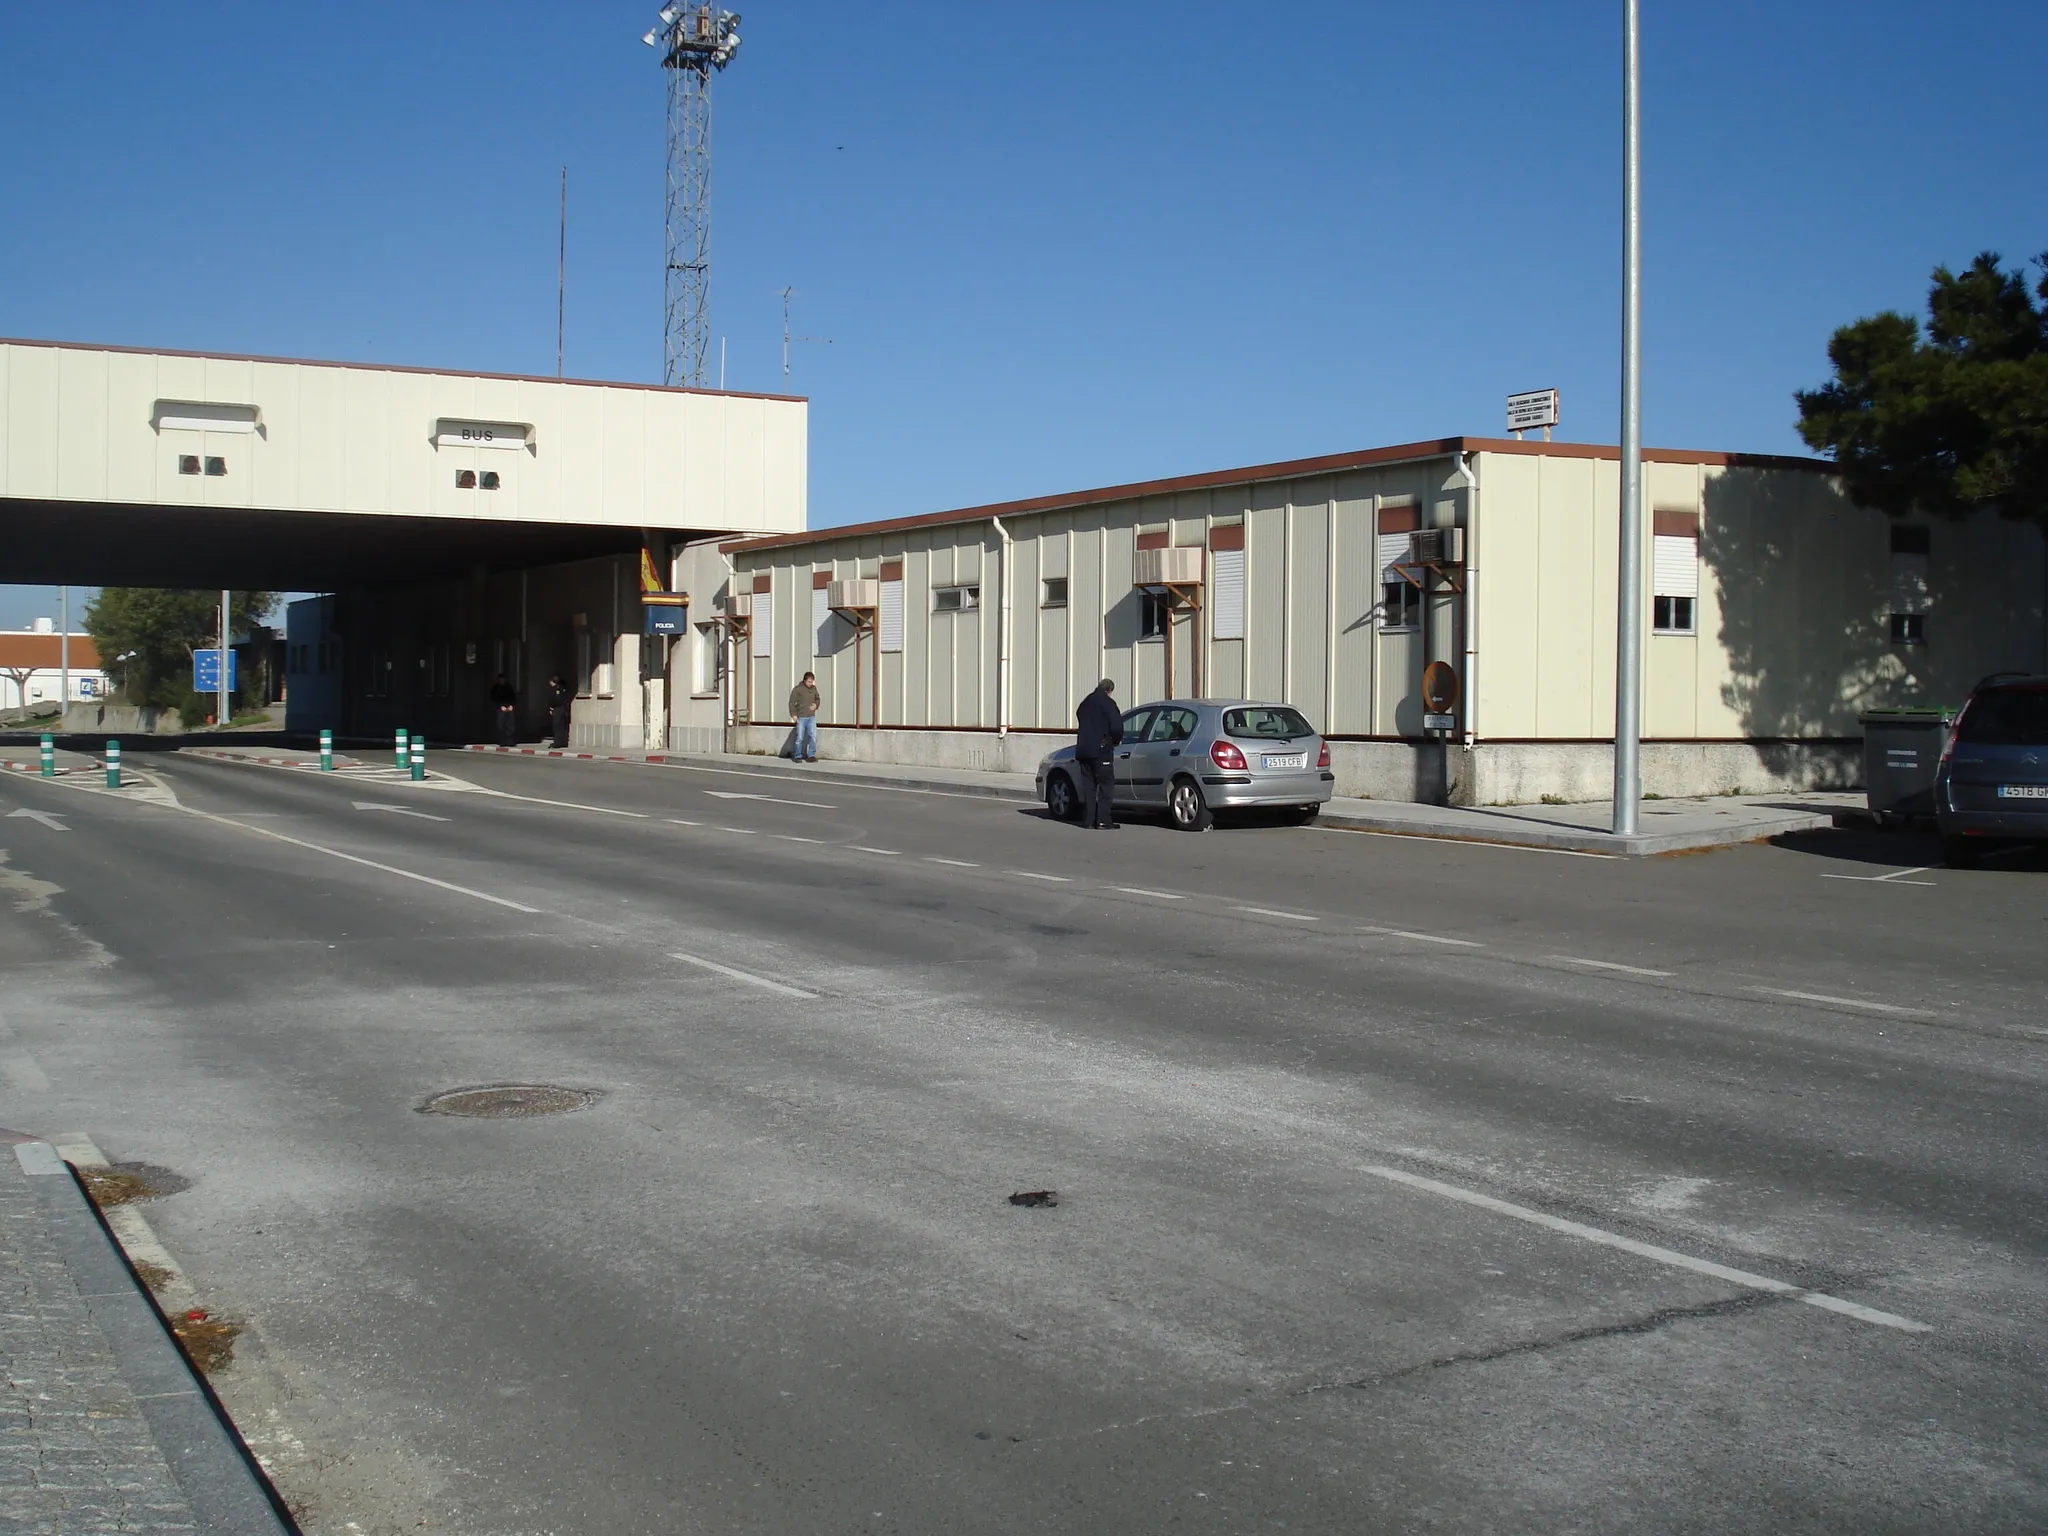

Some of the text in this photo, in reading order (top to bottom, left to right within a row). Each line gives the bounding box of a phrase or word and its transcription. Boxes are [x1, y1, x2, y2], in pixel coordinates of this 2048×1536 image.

[462, 429, 493, 441] BUS
[1268, 757, 1301, 767] 2519 CFB
[2006, 786, 2034, 797] 4518
